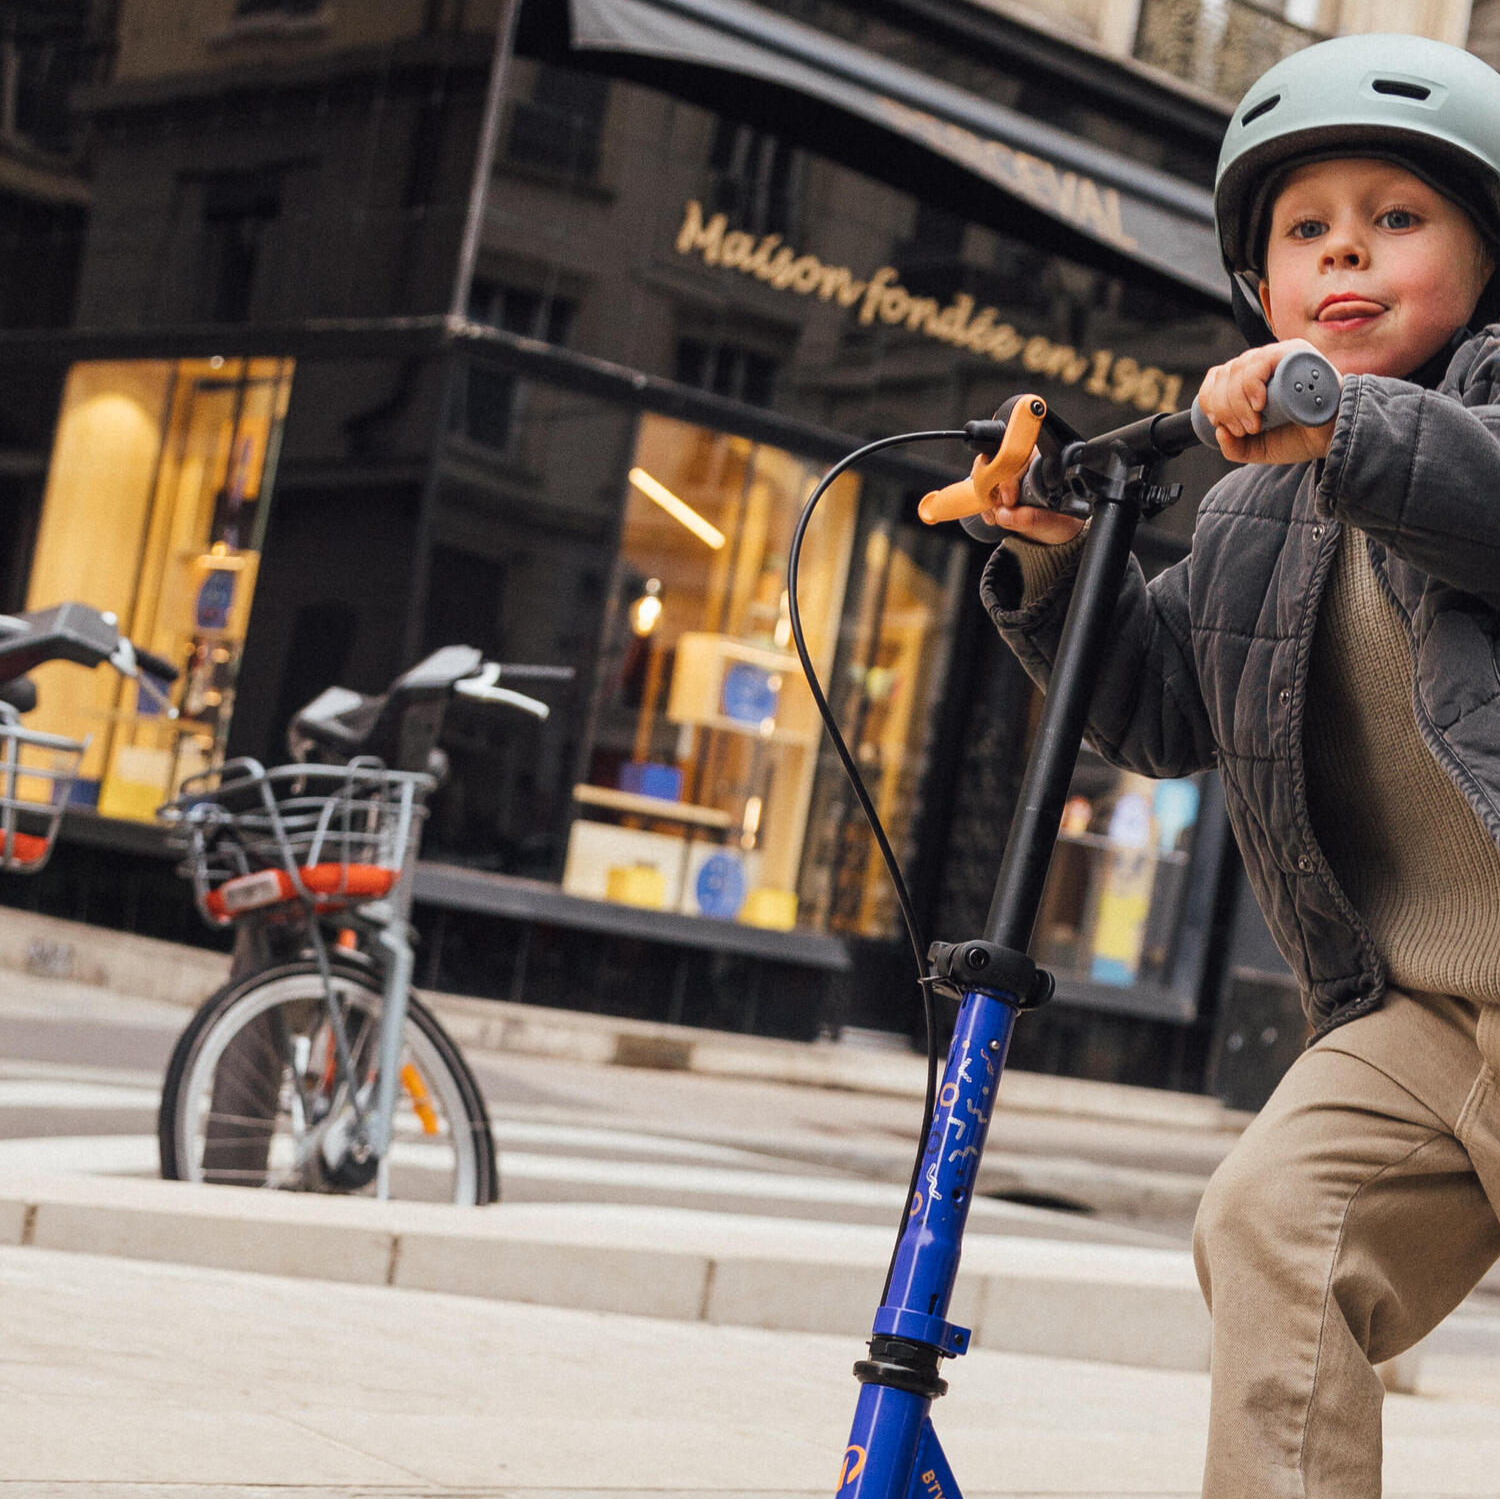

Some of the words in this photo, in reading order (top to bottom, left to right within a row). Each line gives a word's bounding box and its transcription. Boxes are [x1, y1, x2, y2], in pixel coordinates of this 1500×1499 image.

[675, 198, 866, 308] Maison
[1022, 336, 1087, 385] en
[1085, 349, 1183, 414] 1961
